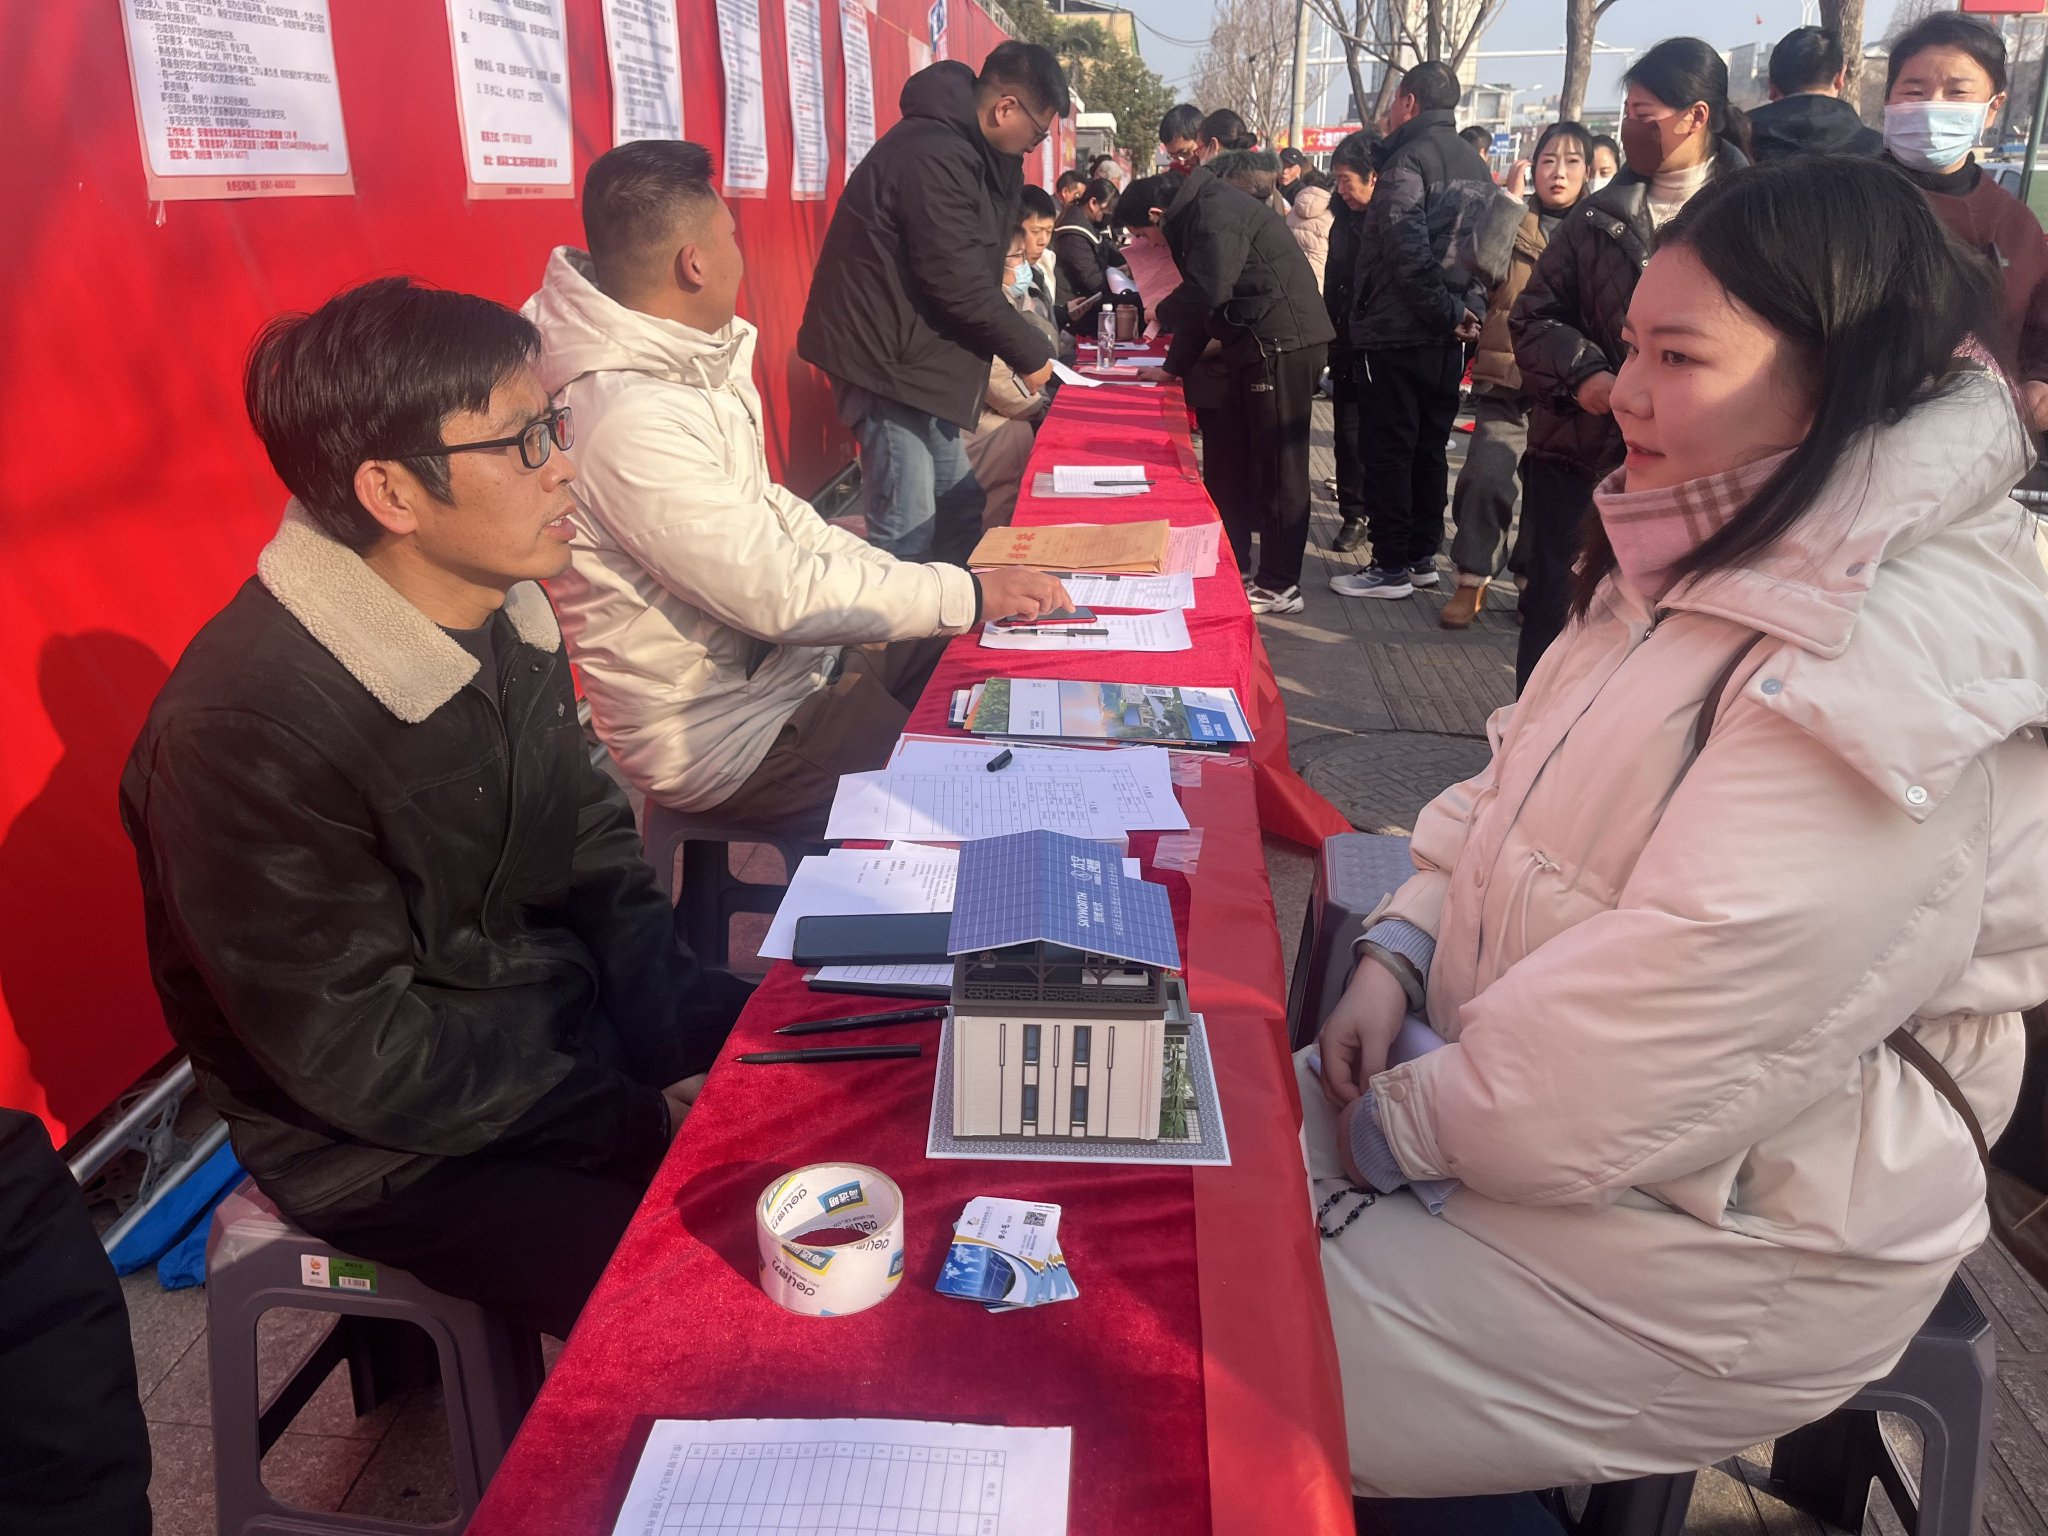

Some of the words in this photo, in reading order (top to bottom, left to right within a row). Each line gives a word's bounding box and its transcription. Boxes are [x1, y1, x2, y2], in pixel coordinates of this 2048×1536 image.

[1076, 891, 1090, 928] SKYWORTH
[828, 1188, 860, 1208] 高透明
